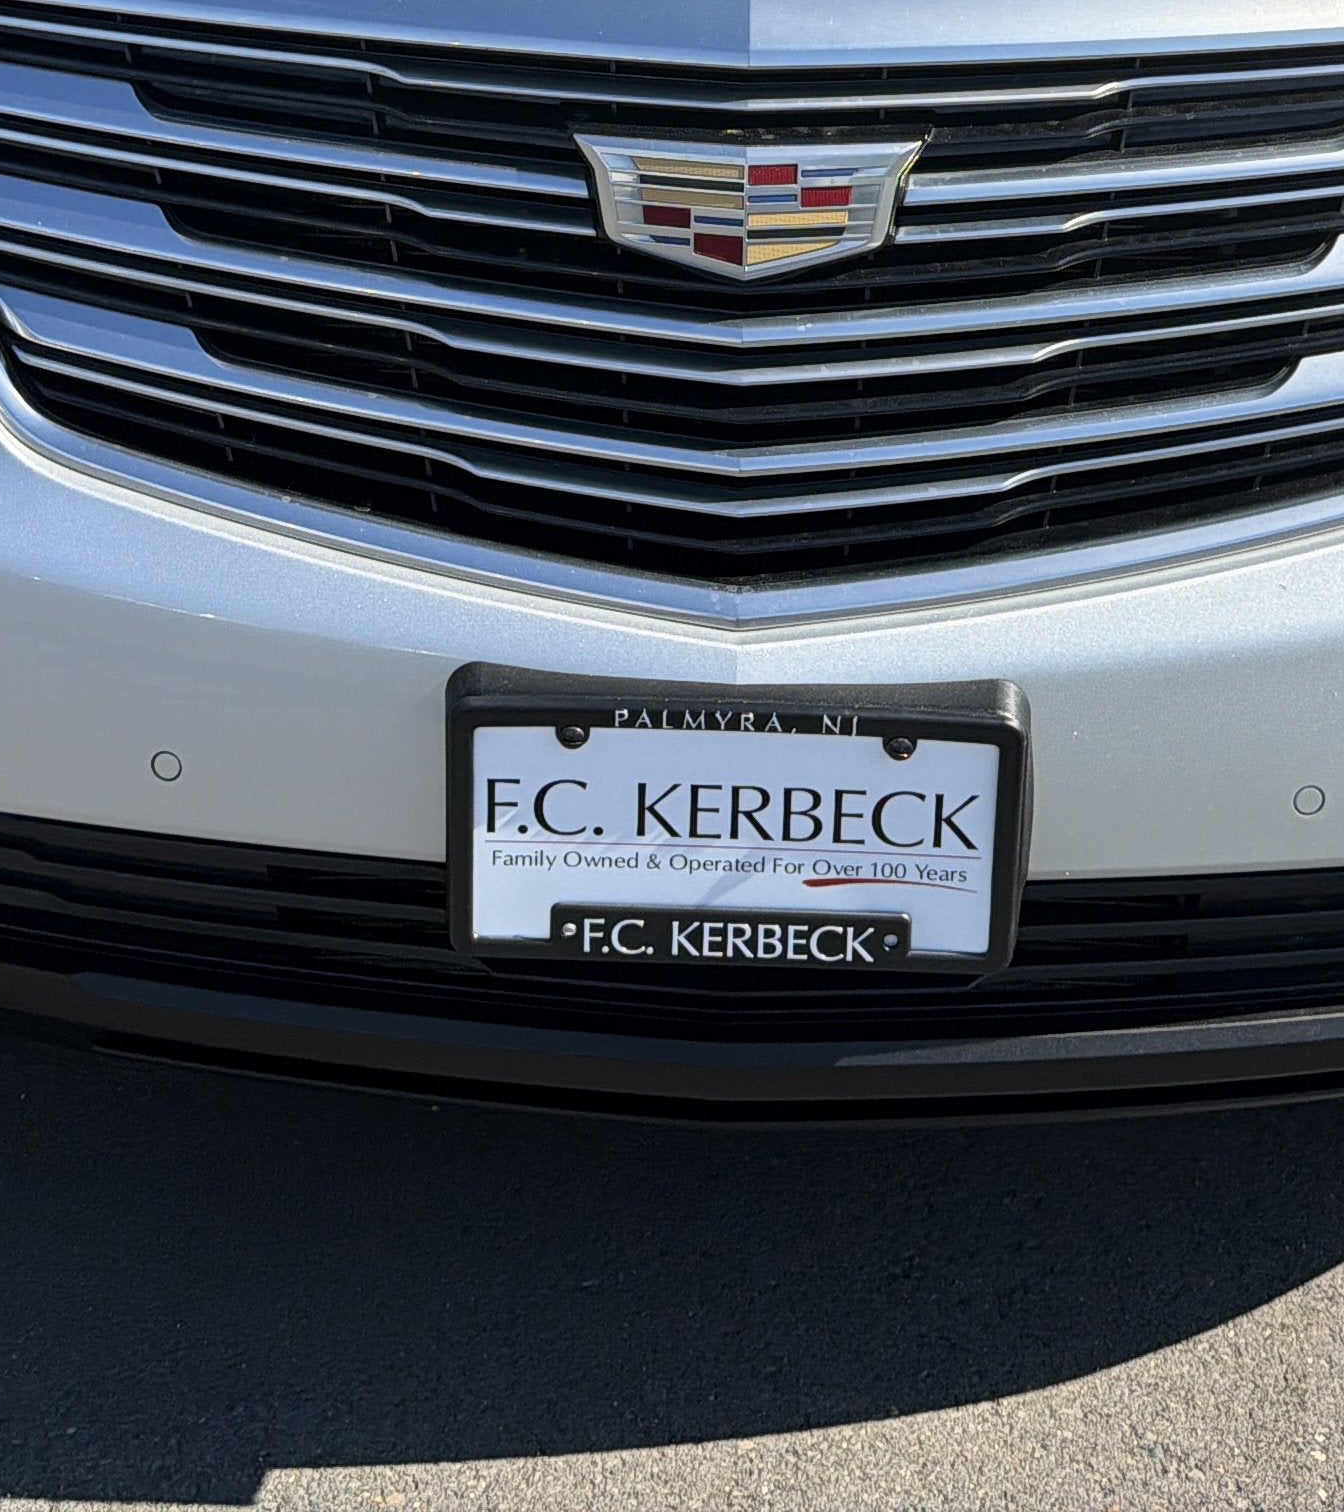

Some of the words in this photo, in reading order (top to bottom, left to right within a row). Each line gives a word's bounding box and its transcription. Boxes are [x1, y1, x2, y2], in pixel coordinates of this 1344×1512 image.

[486, 778, 604, 837] F.C.
[636, 782, 979, 850] KERBECK
[492, 850, 556, 873] Family
[563, 851, 639, 870] Owned
[647, 853, 662, 870] &
[669, 853, 766, 878] Operated
[773, 857, 805, 875] For
[812, 859, 863, 878] Over
[870, 861, 907, 879] 100
[914, 863, 968, 882] Years
[582, 918, 654, 956] F.C.
[671, 921, 875, 963] KERBECK
